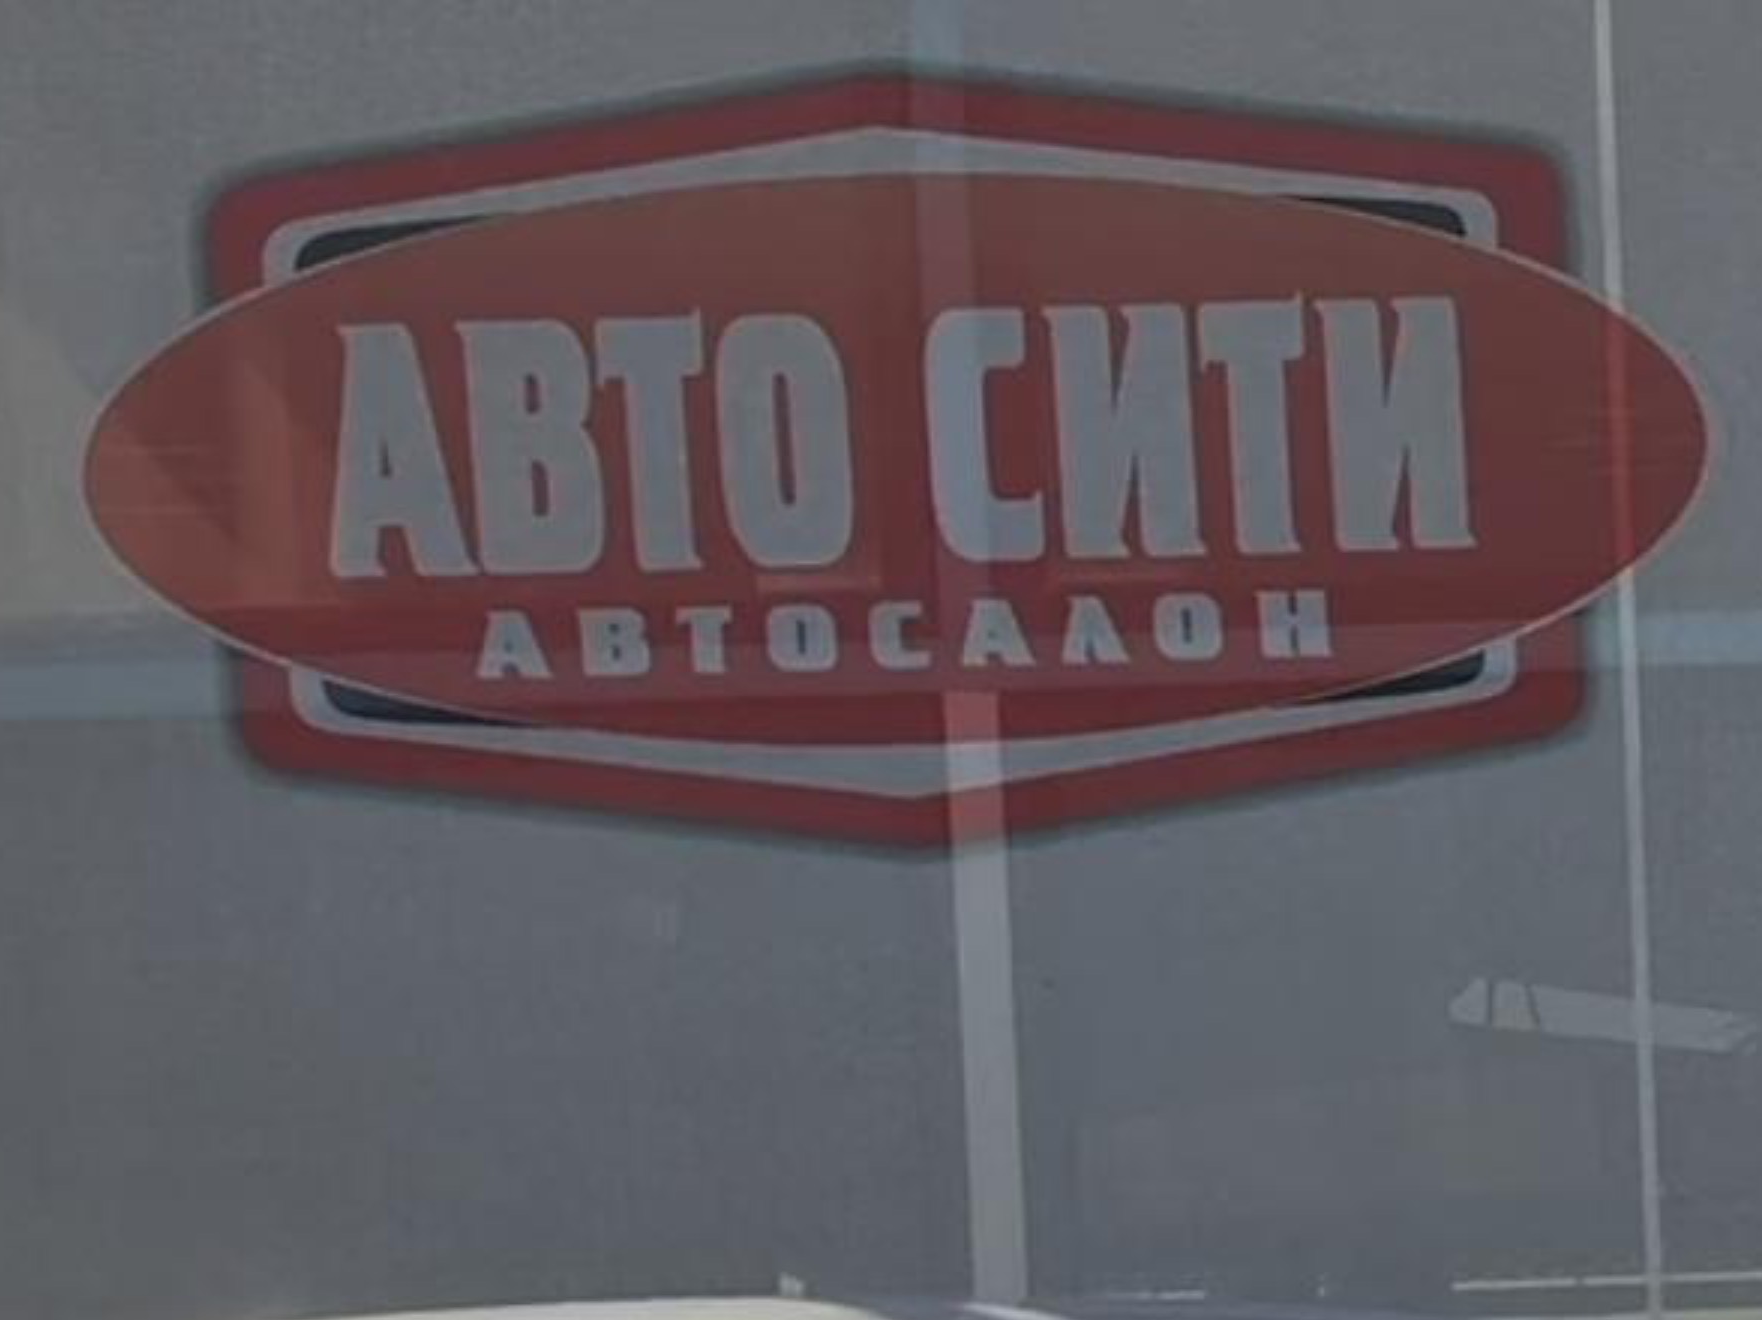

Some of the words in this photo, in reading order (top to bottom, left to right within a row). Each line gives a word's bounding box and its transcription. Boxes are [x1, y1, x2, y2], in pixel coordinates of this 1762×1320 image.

[329, 307, 854, 578] АВТО
[922, 292, 1477, 564] СИТИ
[476, 589, 1333, 680] АВТОСАЛОН
